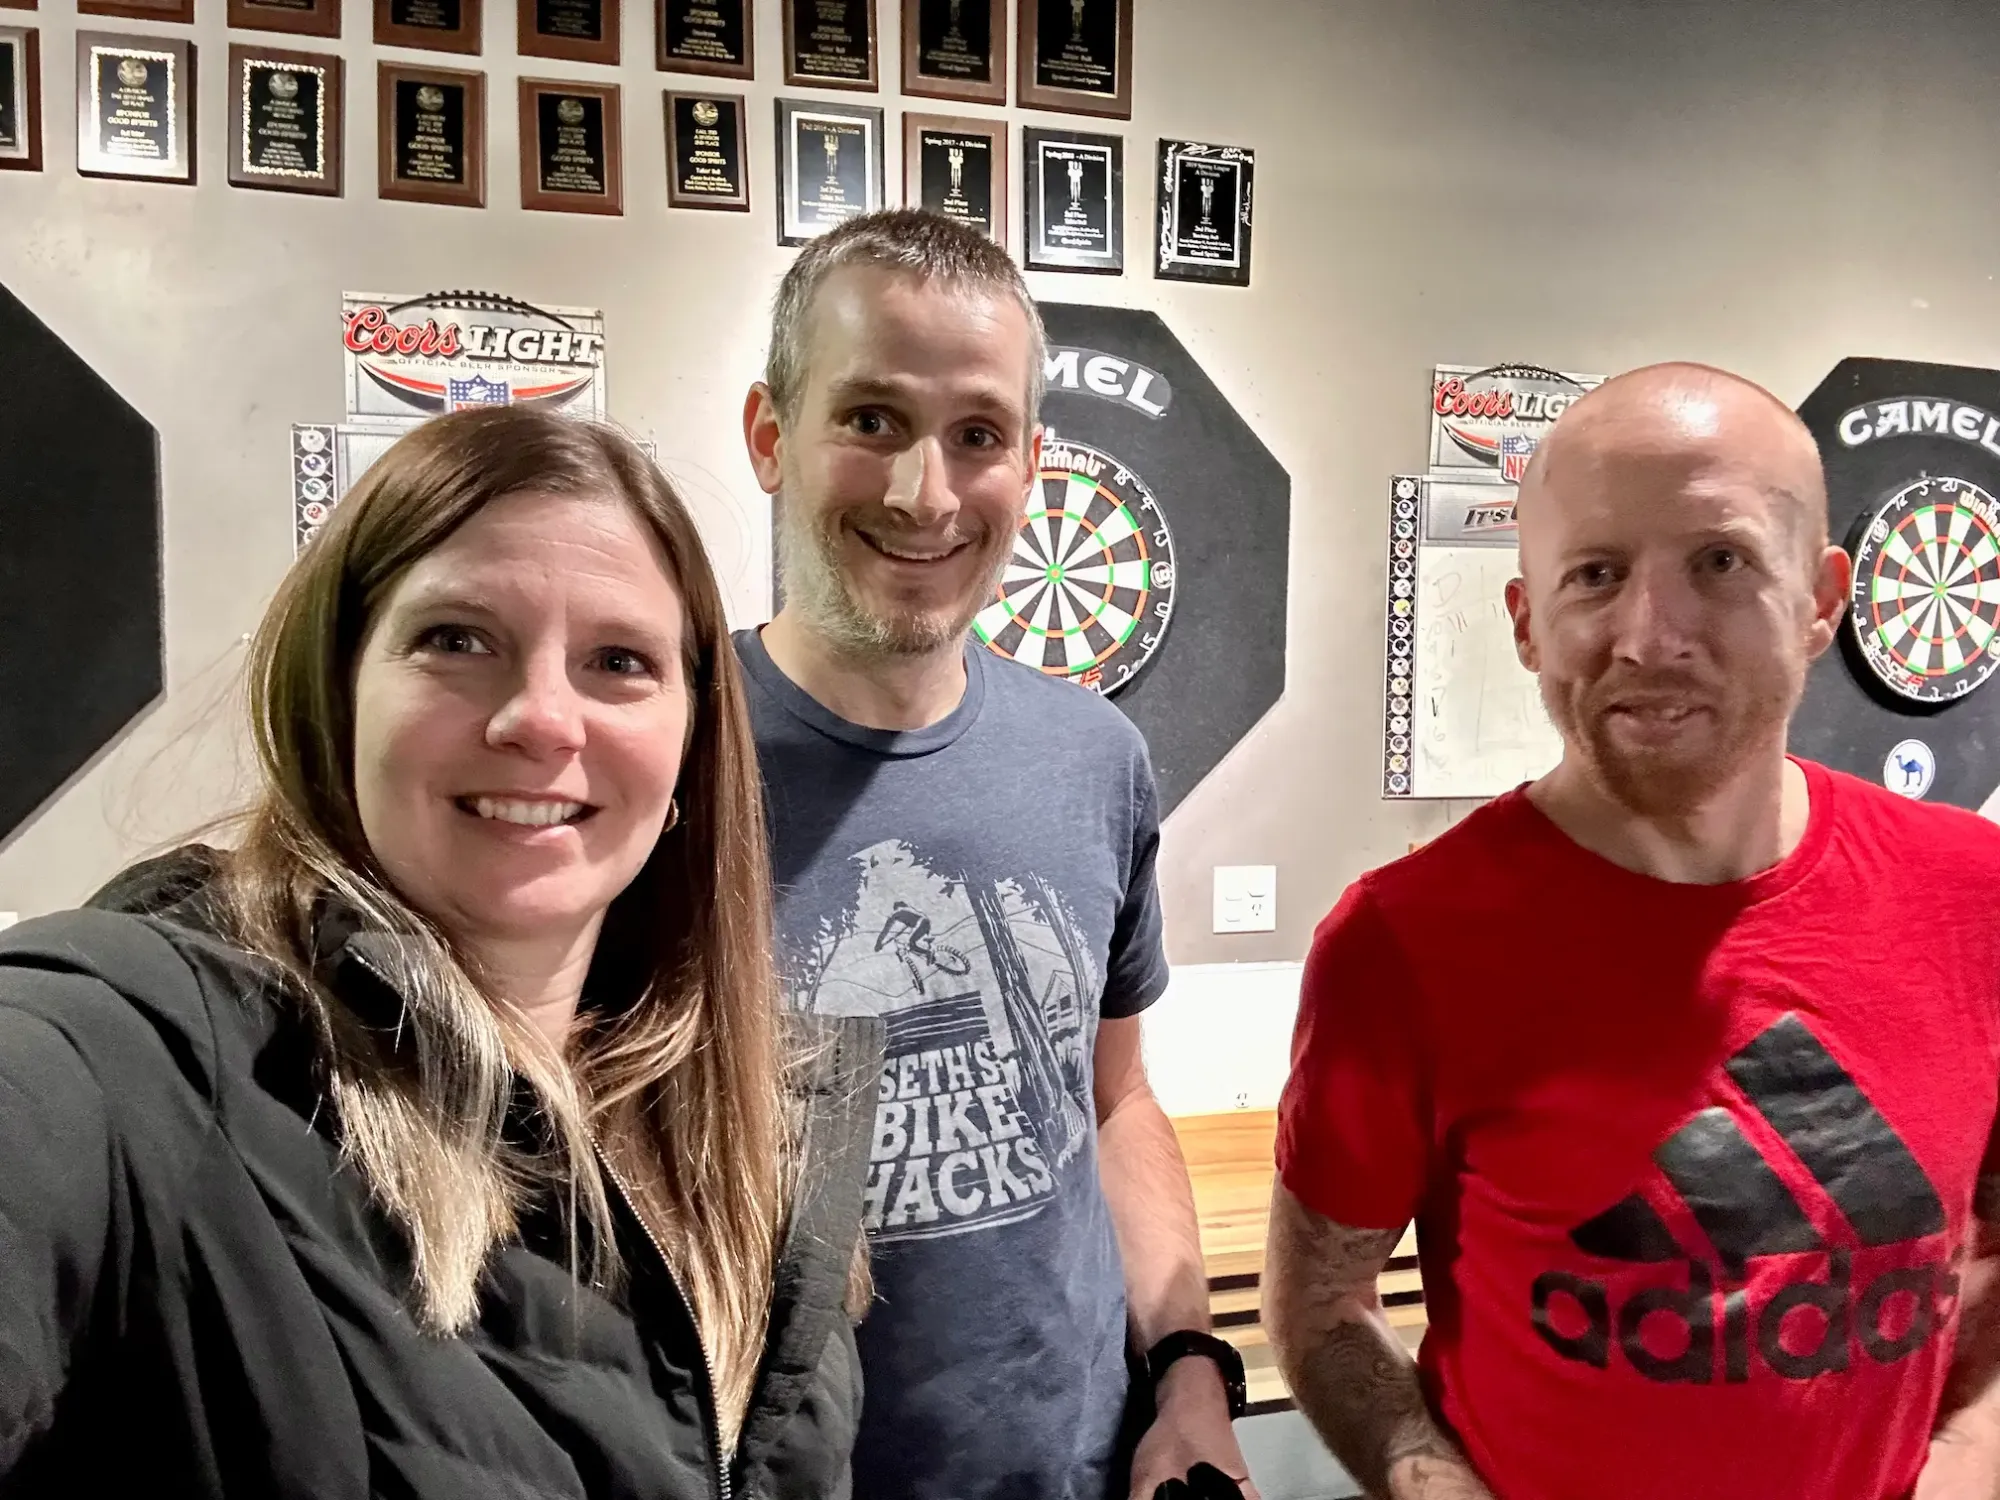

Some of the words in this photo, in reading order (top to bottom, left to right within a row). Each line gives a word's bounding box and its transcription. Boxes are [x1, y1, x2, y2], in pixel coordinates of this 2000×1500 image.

[107, 117, 130, 125] GOOD
[924, 136, 942, 146] Spring
[942, 138, 955, 146] 2017
[965, 140, 987, 150] Division
[689, 156, 707, 164] GOOD
[695, 150, 720, 158] SPONSOR
[1045, 149, 1062, 160] Spring
[1084, 152, 1105, 162] Division
[1199, 163, 1213, 172] Spring
[1200, 170, 1221, 178] Division
[954, 198, 969, 207] Place
[1204, 226, 1217, 234] Place
[1204, 250, 1220, 258] Spirits
[340, 306, 461, 357] Coors
[466, 325, 604, 367] LIGHT
[397, 357, 455, 368] OFFICIAL
[460, 361, 492, 370] BEER
[498, 364, 559, 374] SPONSOR
[1044, 351, 1164, 417] MEL
[1433, 376, 1514, 417] Coors
[1516, 391, 1578, 421] LIG
[1940, 479, 1959, 493] 20
[1464, 508, 1510, 526] IT'S
[879, 1037, 1001, 1102] SETH'S
[870, 1080, 1025, 1163] BIKE
[1530, 1250, 1960, 1386] adida
